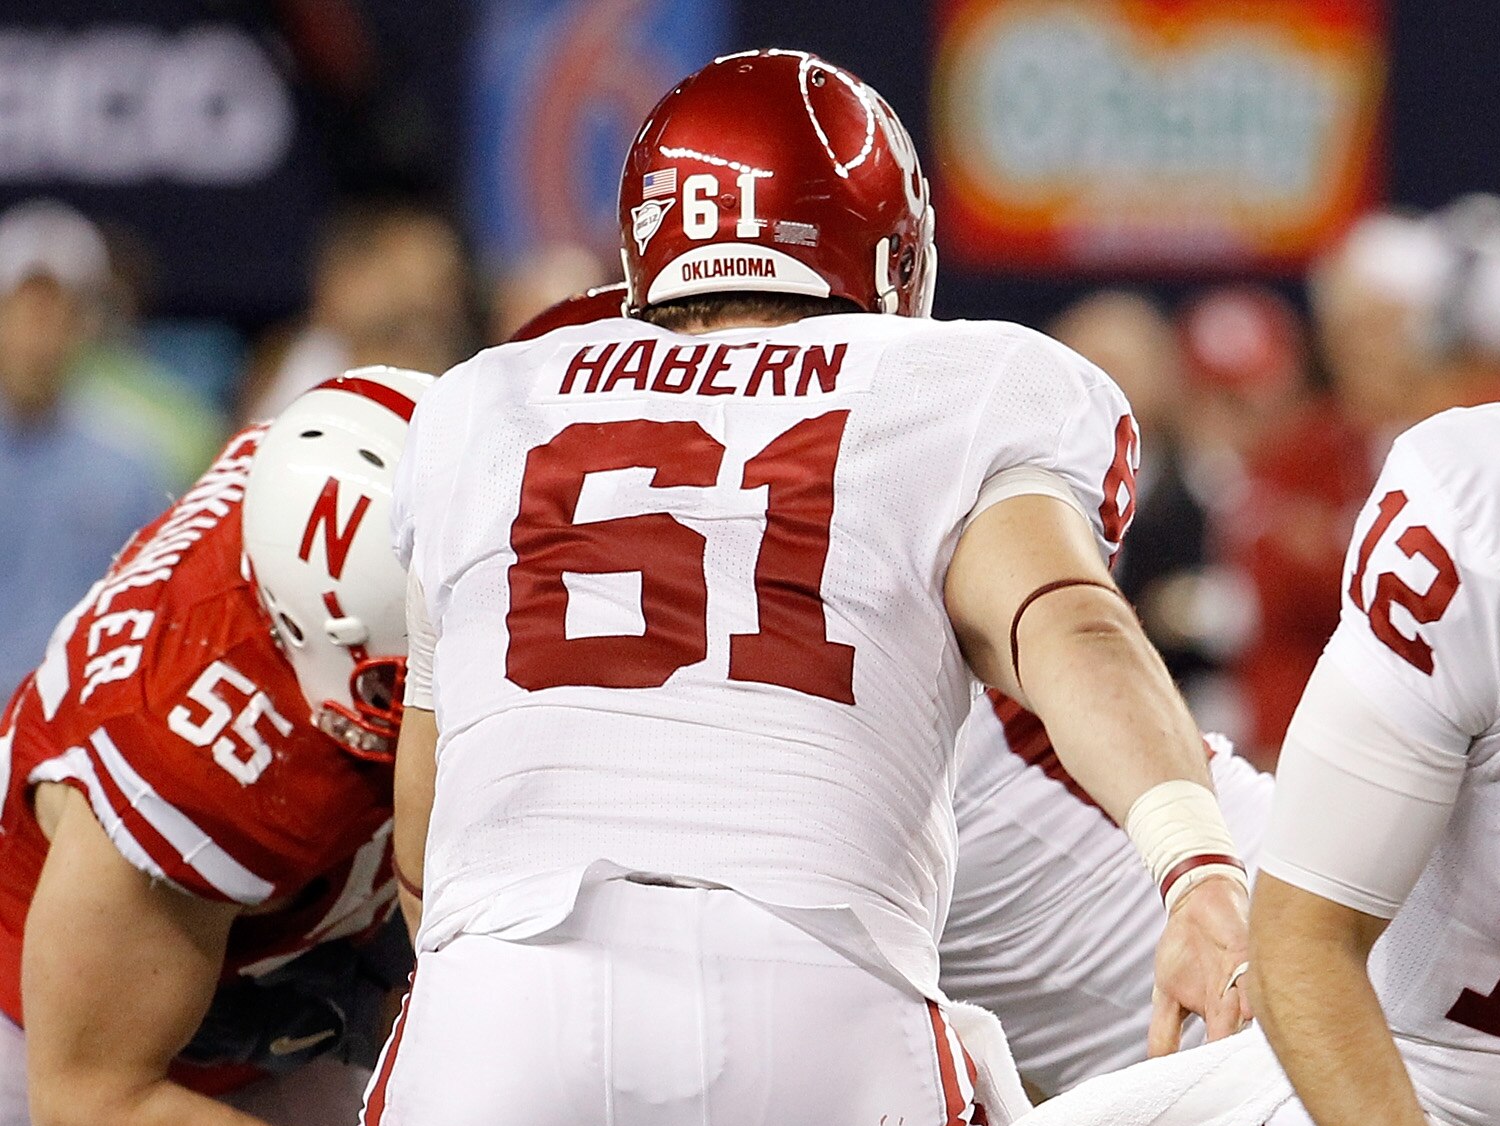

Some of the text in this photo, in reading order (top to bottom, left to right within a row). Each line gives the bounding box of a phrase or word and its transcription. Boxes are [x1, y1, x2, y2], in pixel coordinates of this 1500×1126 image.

[682, 173, 763, 240] 61
[682, 257, 776, 282] OKLAHOMA
[559, 338, 848, 397] HABERN
[298, 475, 372, 580] N
[505, 408, 857, 706] 61
[1348, 489, 1461, 677] 12
[167, 660, 295, 788] 55
